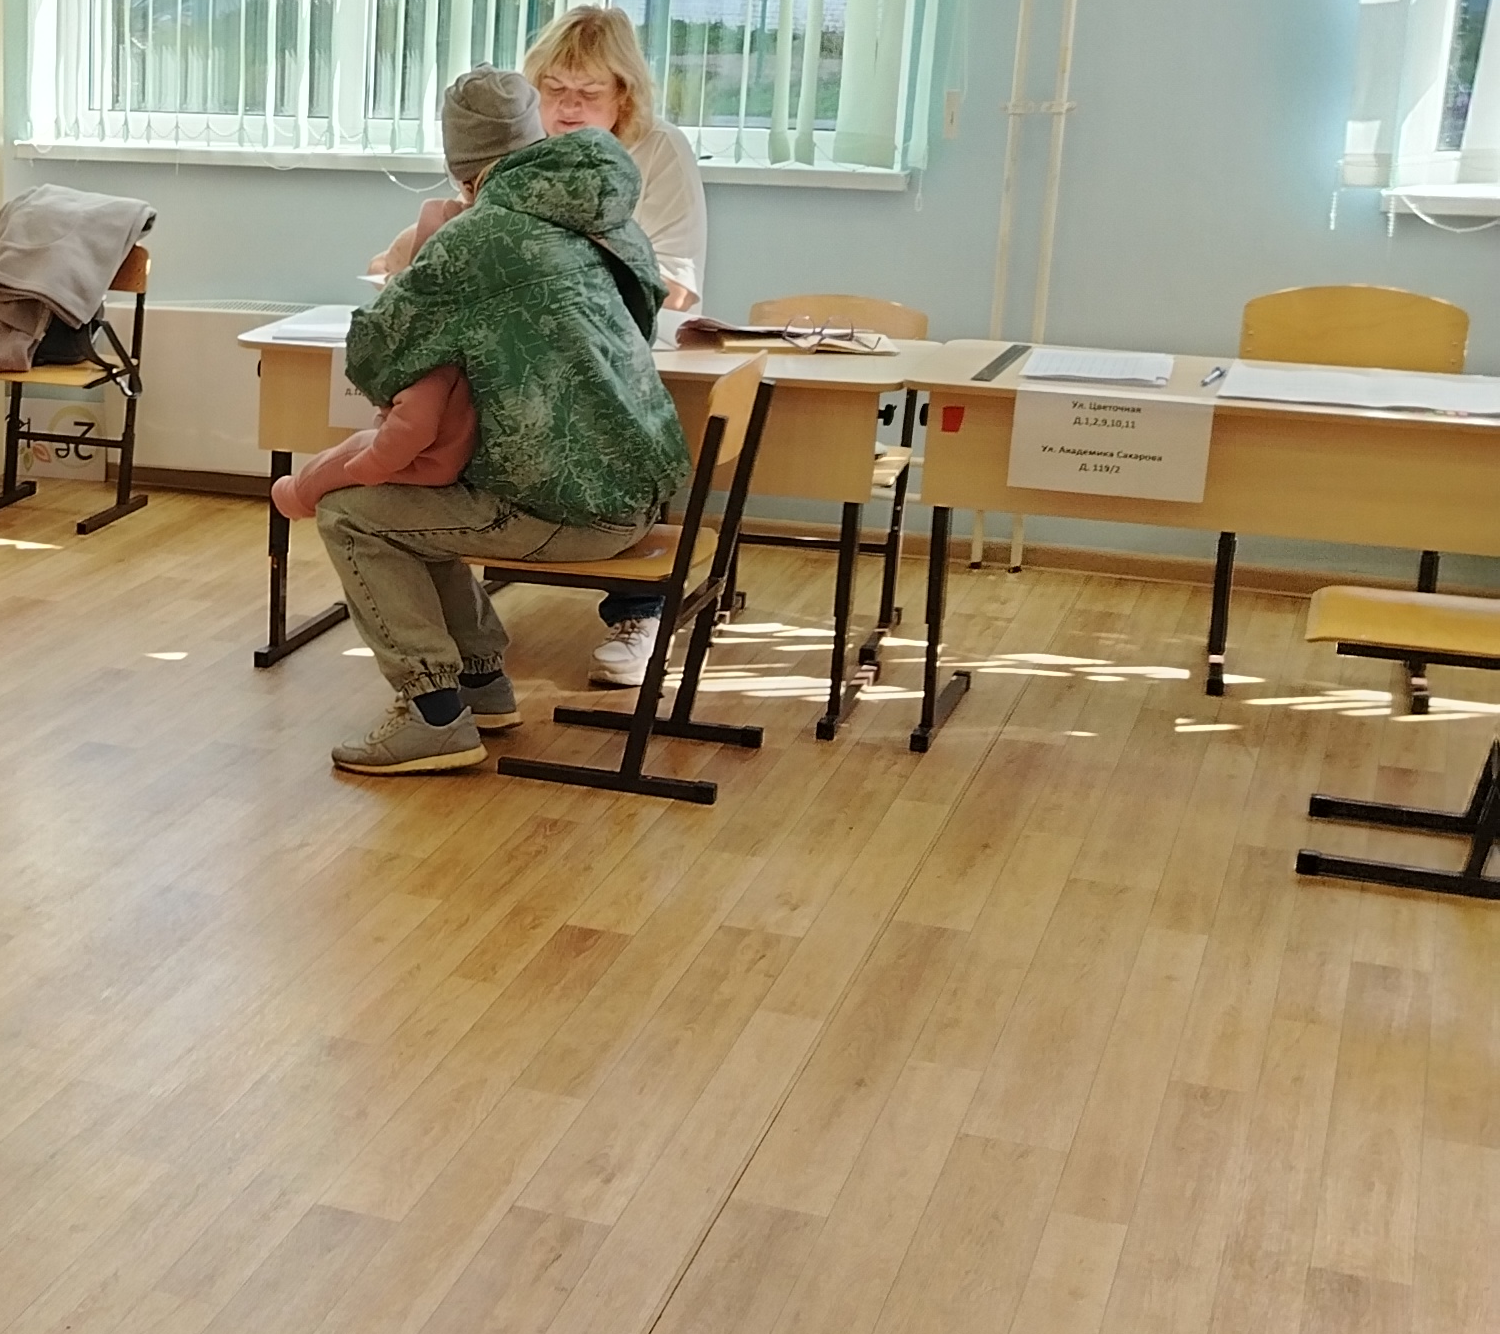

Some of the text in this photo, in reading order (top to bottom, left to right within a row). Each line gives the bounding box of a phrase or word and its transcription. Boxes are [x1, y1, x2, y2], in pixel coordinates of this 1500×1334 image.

[1071, 400, 1142, 414] Ул. Цветочная
[1040, 445, 1057, 453] Ул.
[1058, 445, 1114, 458] Академика
[1092, 463, 1121, 474] 119/2
